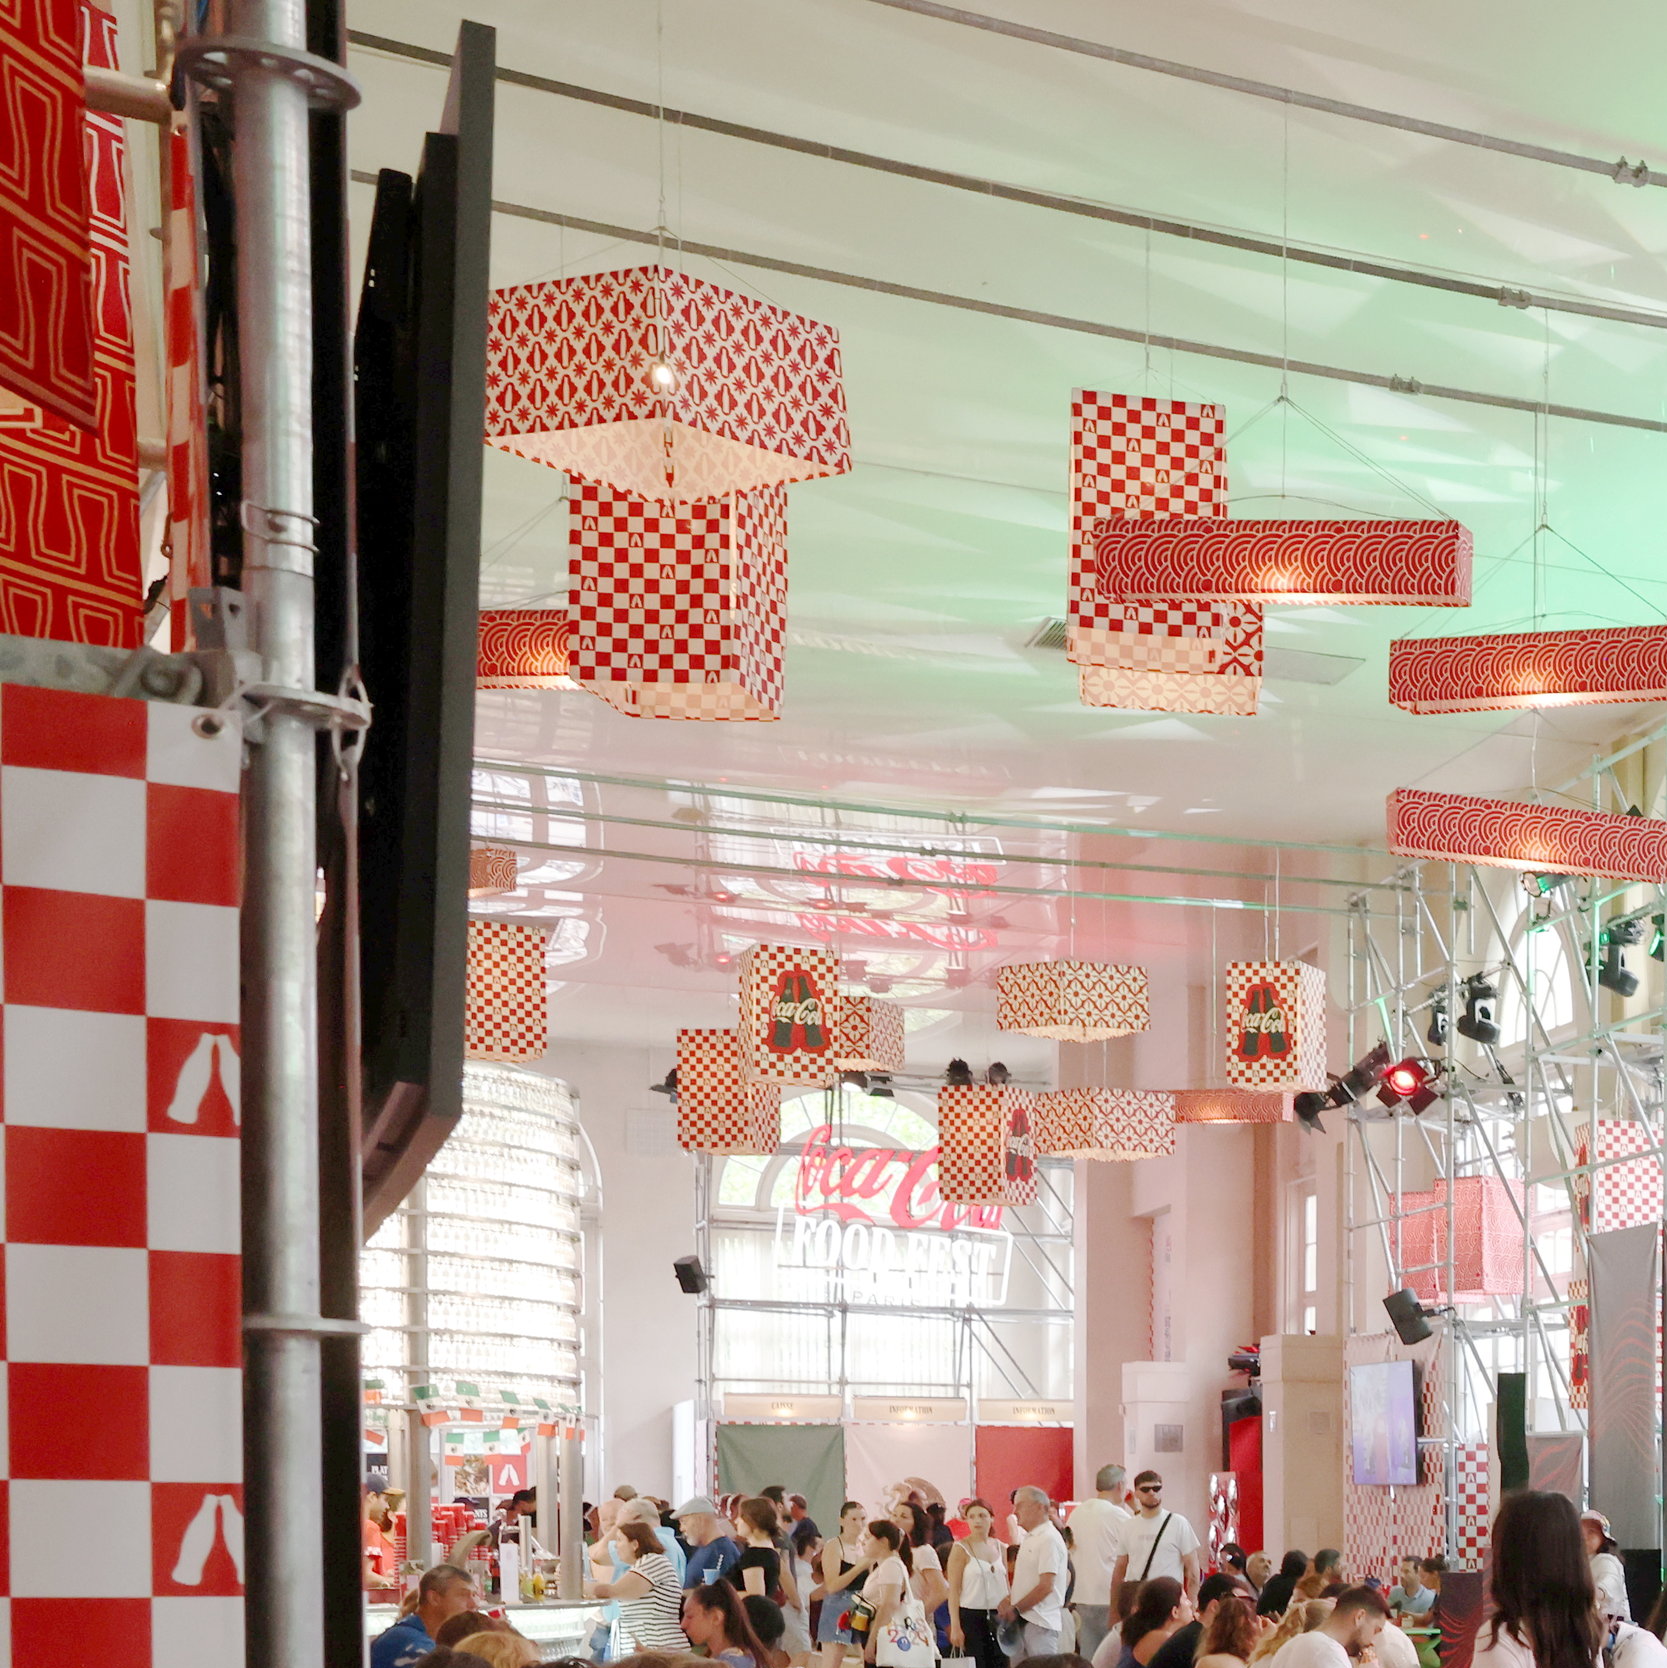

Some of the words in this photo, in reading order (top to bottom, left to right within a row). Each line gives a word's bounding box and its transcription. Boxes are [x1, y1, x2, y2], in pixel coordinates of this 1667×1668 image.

[770, 996, 823, 1025] Coca-Cola
[1241, 1006, 1286, 1034] Coca-Cola
[792, 1215, 897, 1272] FOOD
[906, 1232, 998, 1288] FEST
